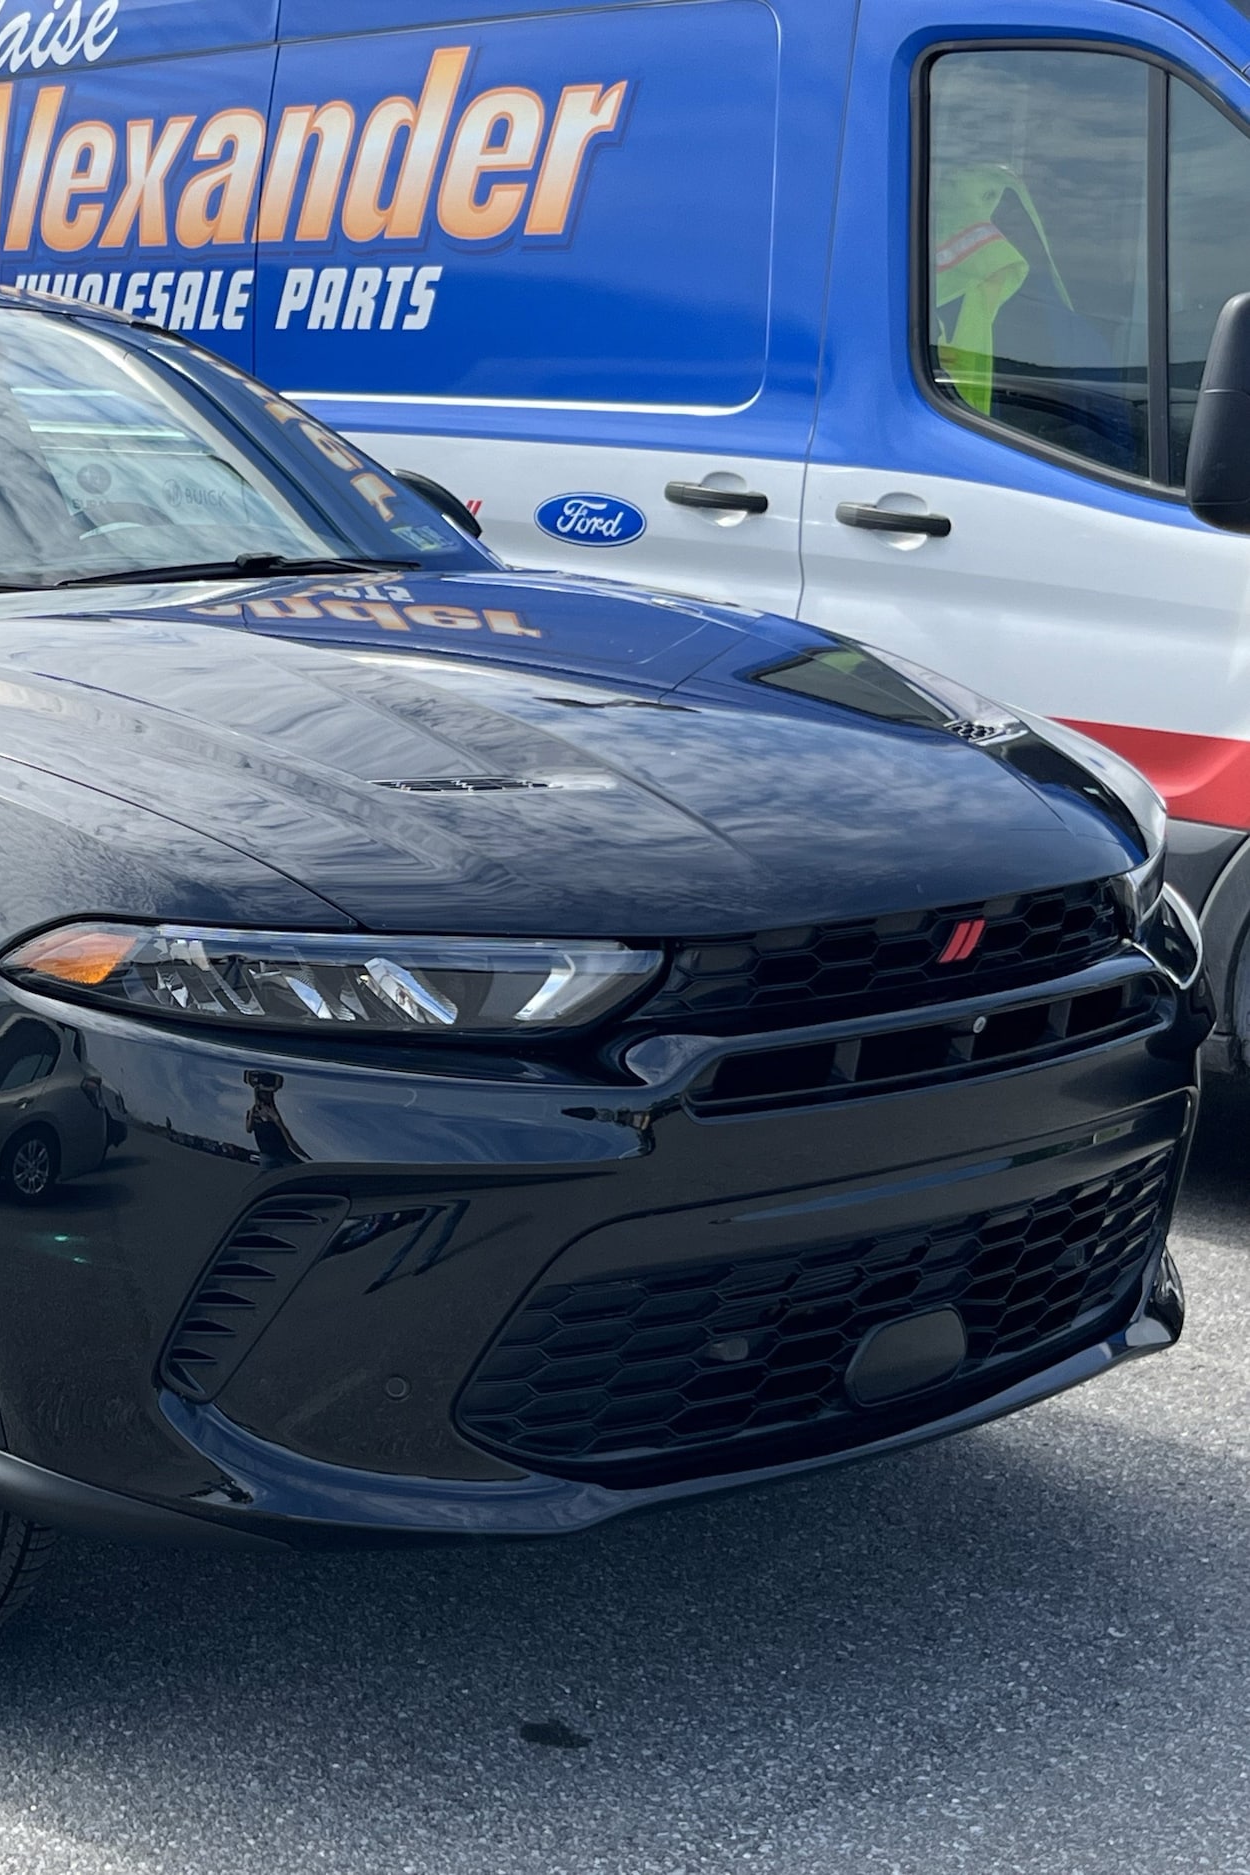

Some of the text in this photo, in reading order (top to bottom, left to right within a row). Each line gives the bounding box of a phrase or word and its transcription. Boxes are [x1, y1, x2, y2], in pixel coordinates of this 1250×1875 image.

[15, 266, 443, 331] LESALE PARTS
[184, 487, 227, 506] BUICK
[556, 500, 623, 537] Ford
